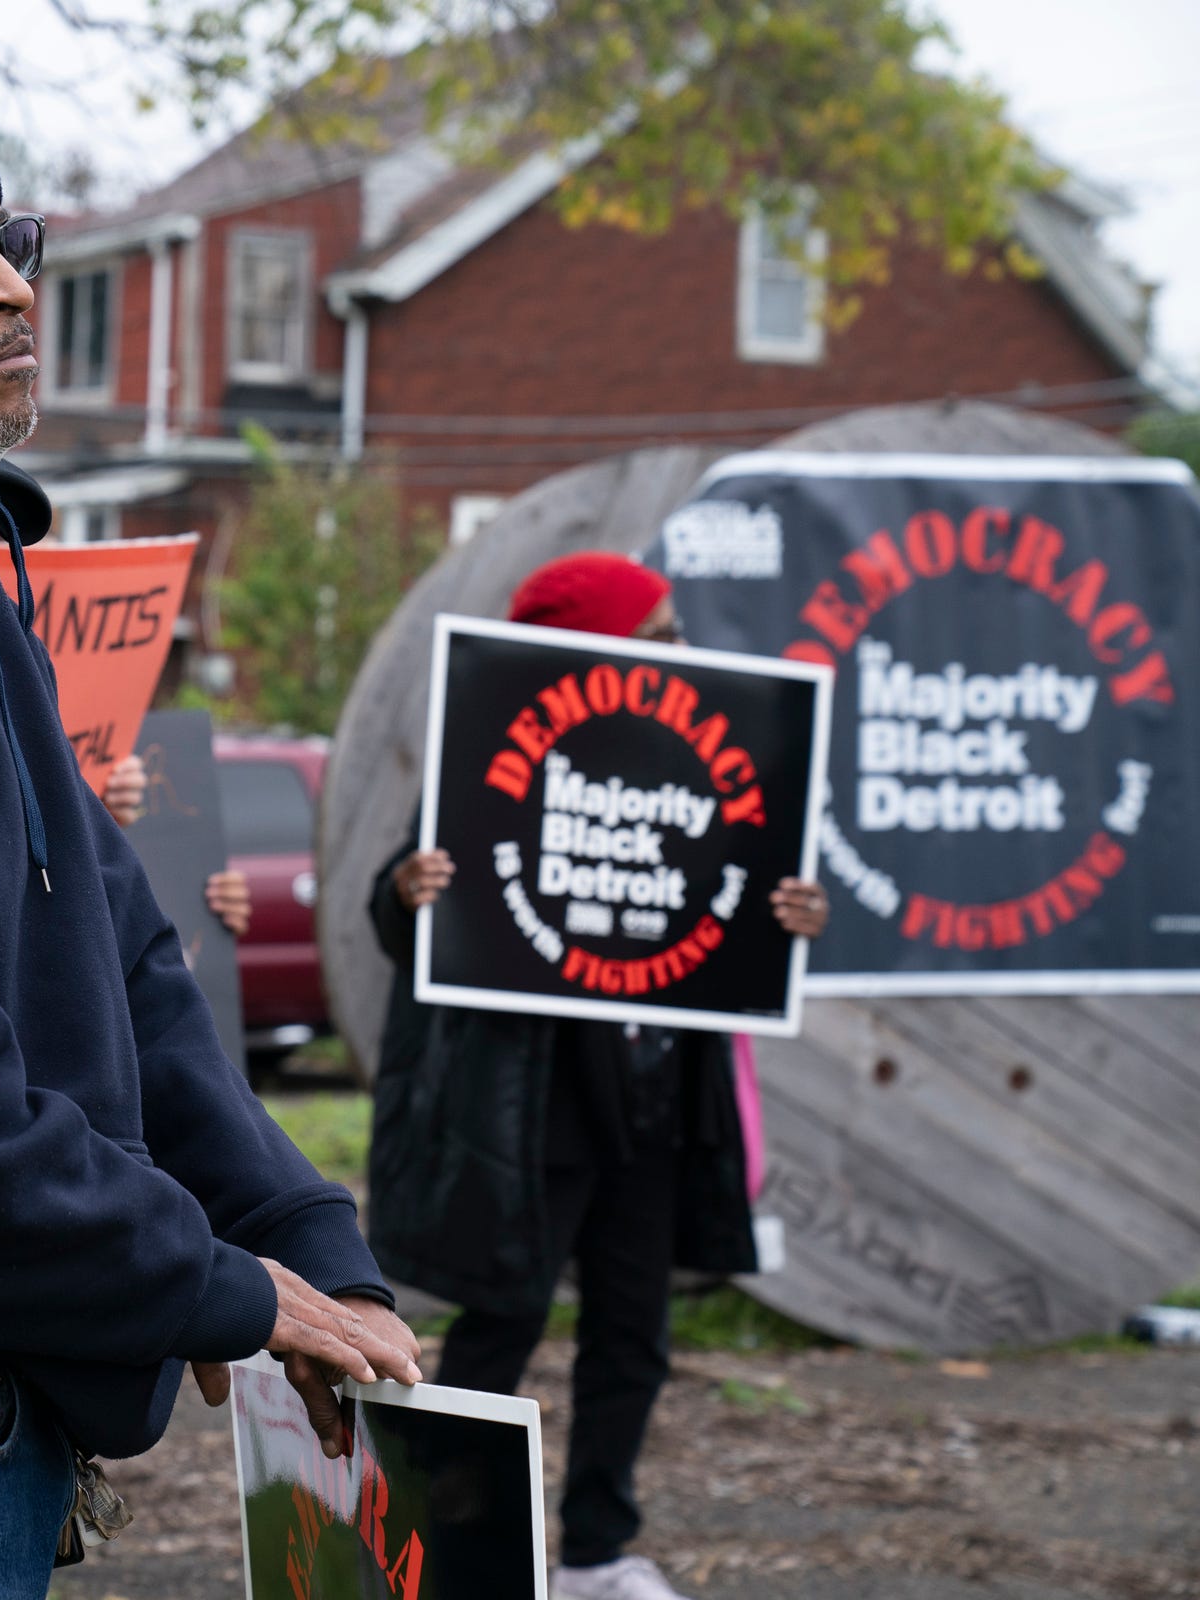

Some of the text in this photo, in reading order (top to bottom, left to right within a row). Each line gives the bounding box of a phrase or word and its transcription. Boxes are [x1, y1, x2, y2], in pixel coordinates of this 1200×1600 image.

[857, 661, 1097, 734] Majority
[484, 662, 767, 828] DEMOCRACY
[857, 721, 1029, 776] Black
[543, 771, 716, 838] Majority
[857, 776, 1065, 832] Detroit
[541, 811, 664, 865] Black
[538, 853, 687, 911] Detroit
[901, 831, 1127, 951] FIGHTING
[560, 914, 725, 996] FIGHTING
